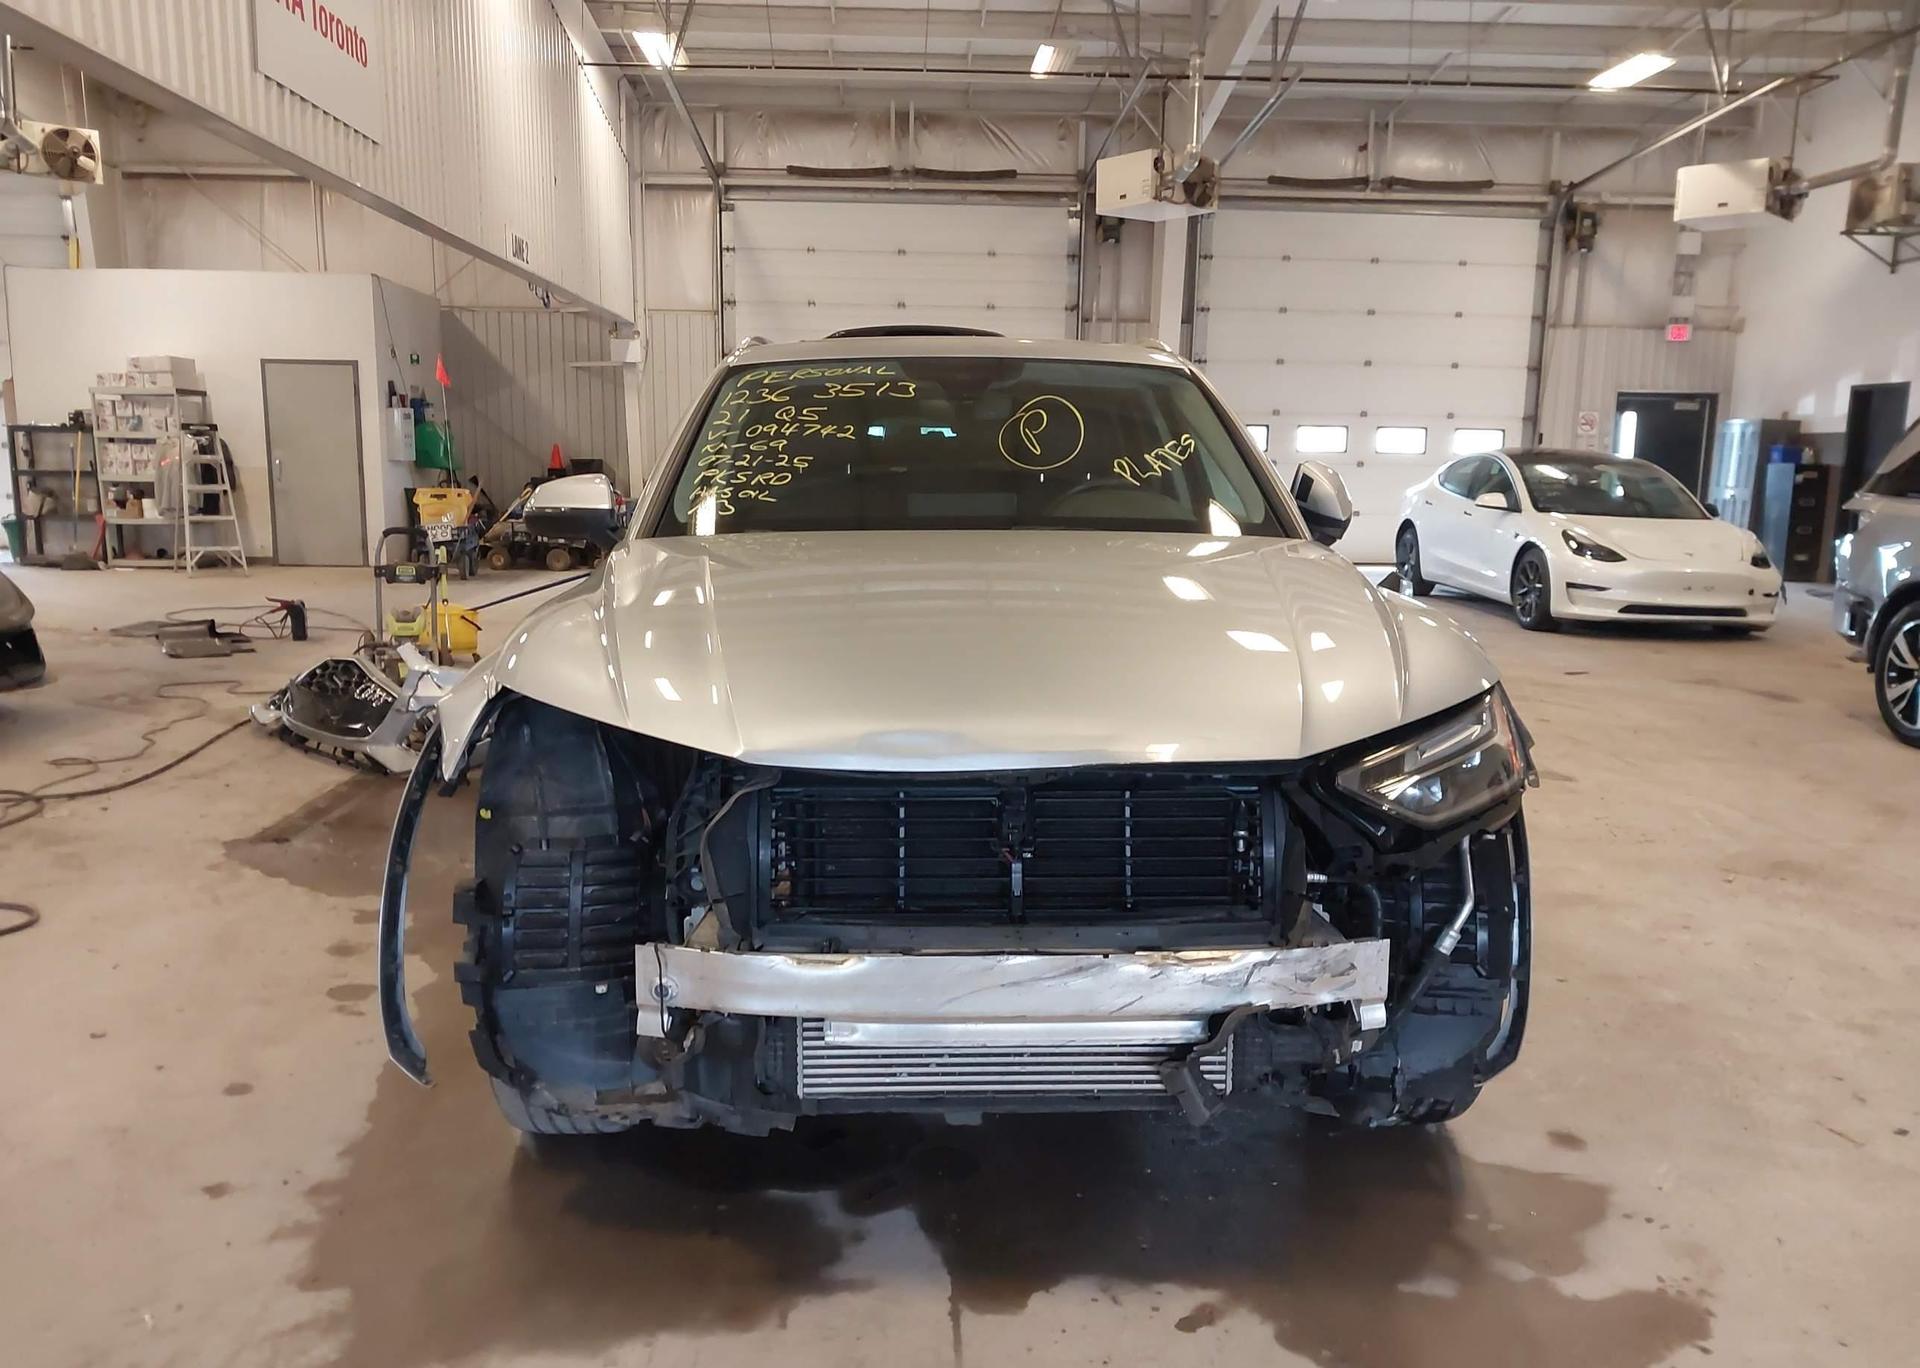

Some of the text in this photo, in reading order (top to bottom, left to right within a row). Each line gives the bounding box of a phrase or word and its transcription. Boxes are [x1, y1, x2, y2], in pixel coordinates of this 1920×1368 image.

[720, 382, 917, 406] 1236 3513
[712, 406, 829, 426] 21 Q5
[1019, 408, 1048, 456] P
[1112, 433, 1196, 487] PLATES
